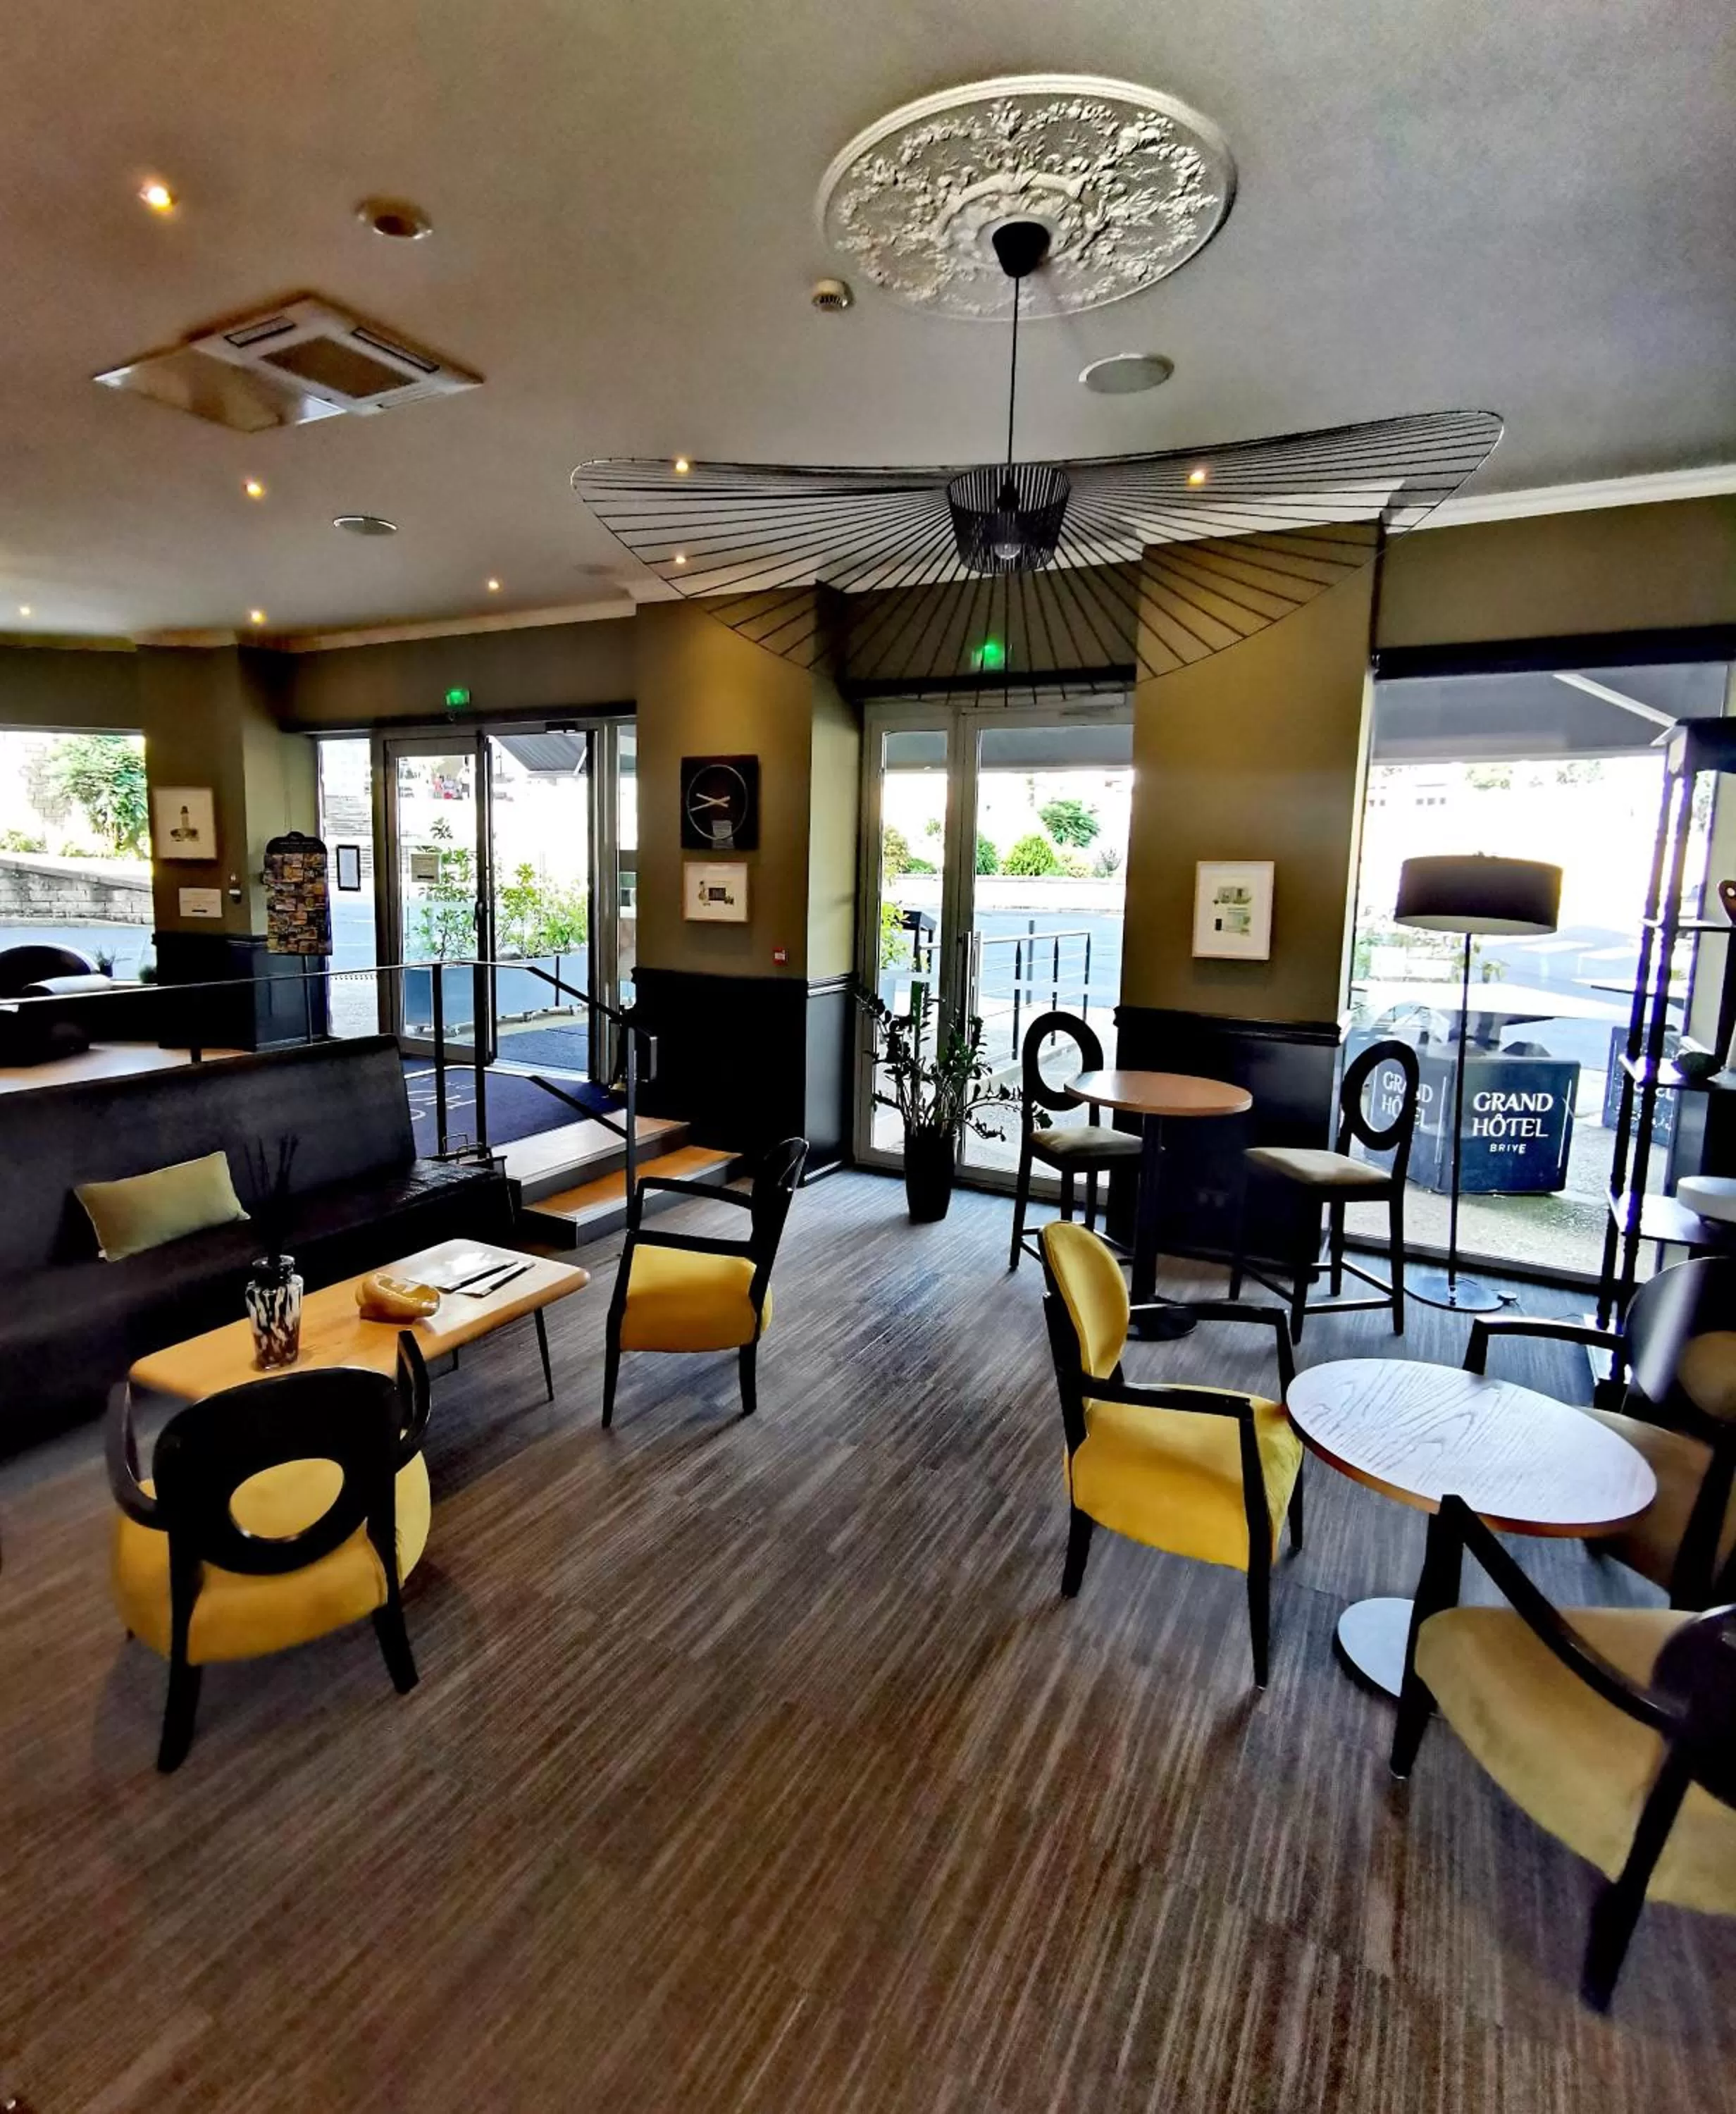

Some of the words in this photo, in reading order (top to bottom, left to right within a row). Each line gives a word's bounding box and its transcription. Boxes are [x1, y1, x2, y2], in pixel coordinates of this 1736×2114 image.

[1383, 1071, 1434, 1103] GRD
[1473, 1092, 1554, 1112] GRAND
[1472, 1113, 1549, 1137] HÔTEL
[1489, 1143, 1527, 1154] BRIVE
